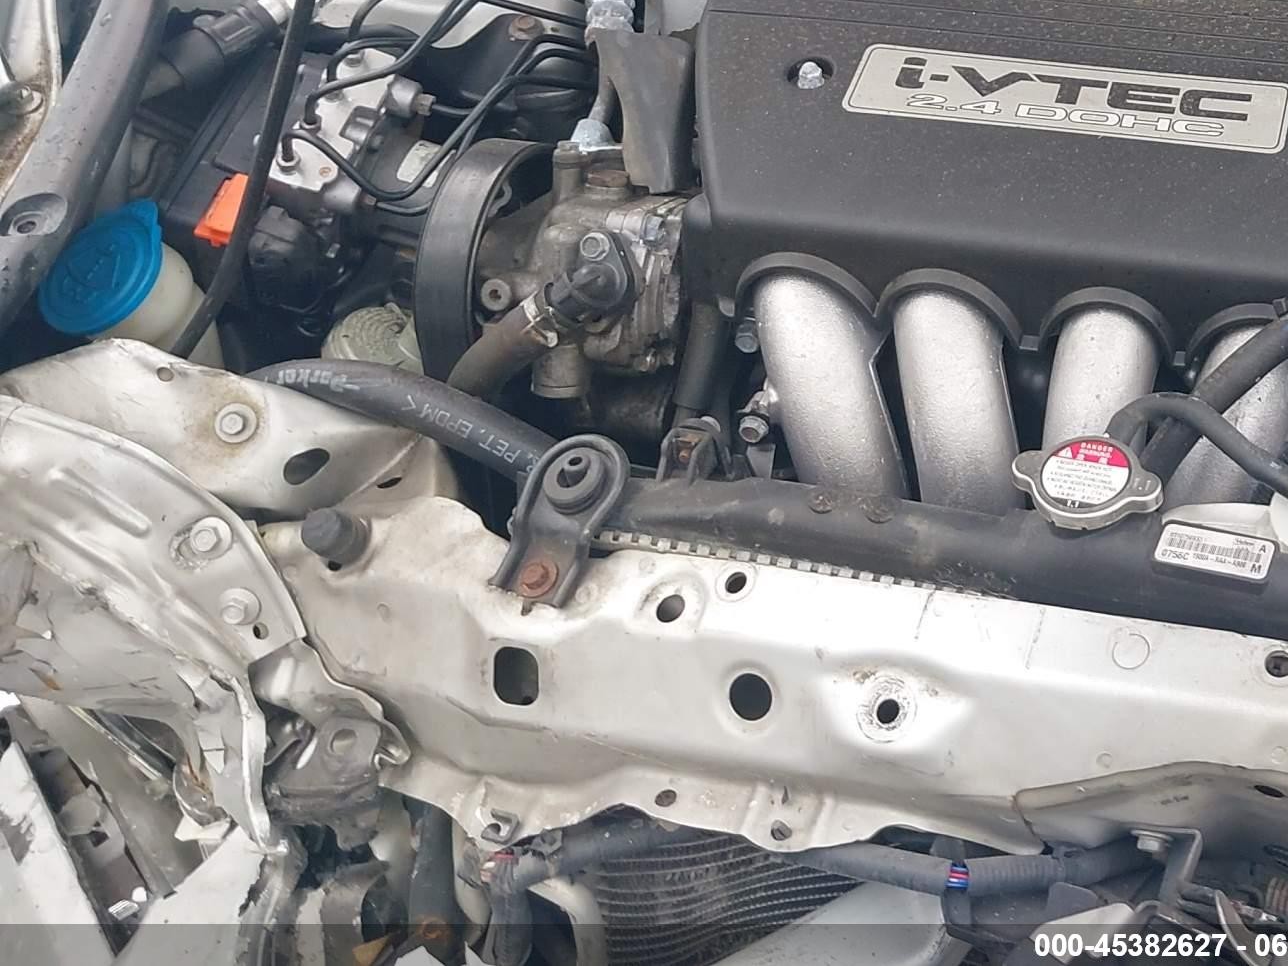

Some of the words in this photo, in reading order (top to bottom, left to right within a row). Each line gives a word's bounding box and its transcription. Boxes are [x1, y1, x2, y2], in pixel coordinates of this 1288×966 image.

[895, 56, 1252, 122] i-VTEC
[906, 93, 1002, 116] 2.4
[1016, 103, 1225, 137] DOHC
[1080, 442, 1113, 453] DANGER
[1258, 543, 1268, 554] A
[1250, 563, 1262, 574] M
